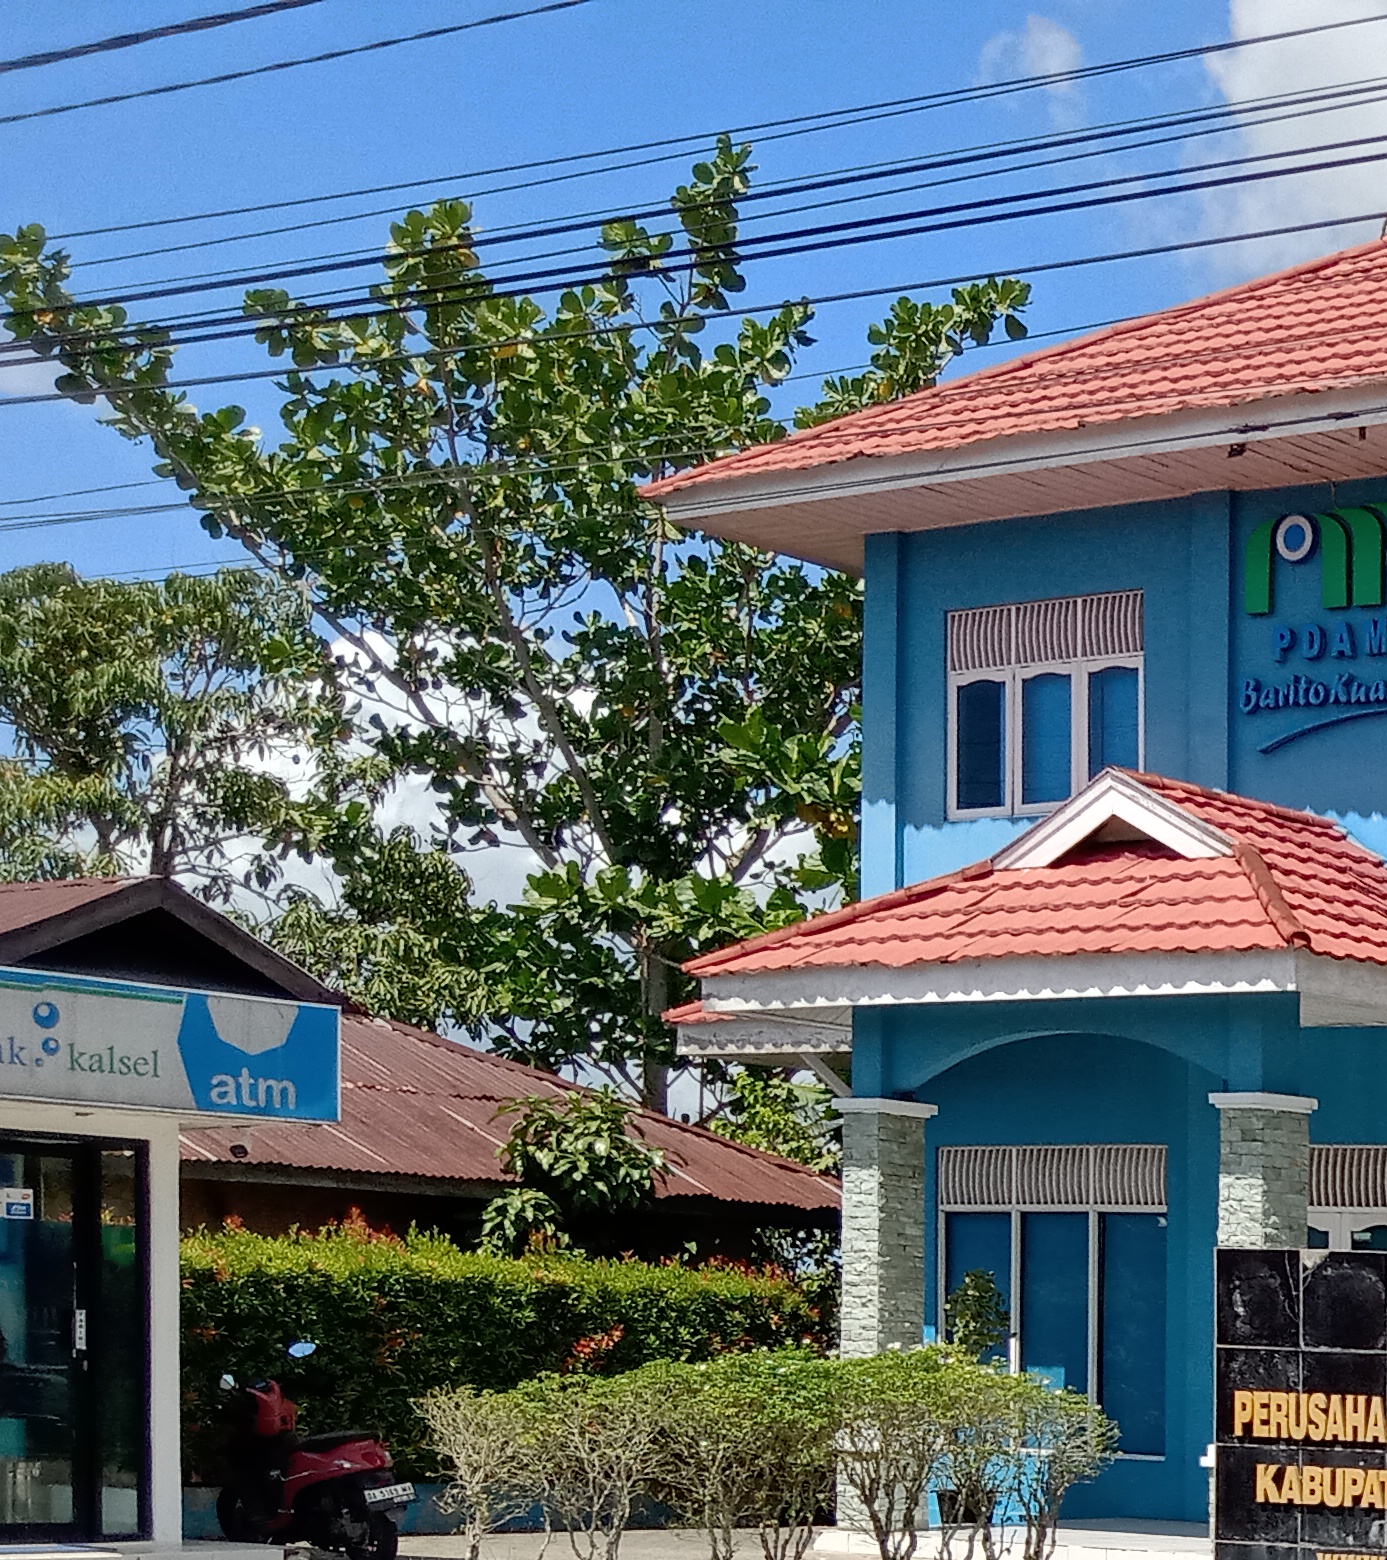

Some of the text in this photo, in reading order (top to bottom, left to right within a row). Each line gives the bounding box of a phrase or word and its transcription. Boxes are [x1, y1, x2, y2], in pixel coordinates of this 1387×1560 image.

[1240, 673, 1325, 714] Barito
[67, 1042, 160, 1078] kalsel
[210, 1066, 297, 1110] atm
